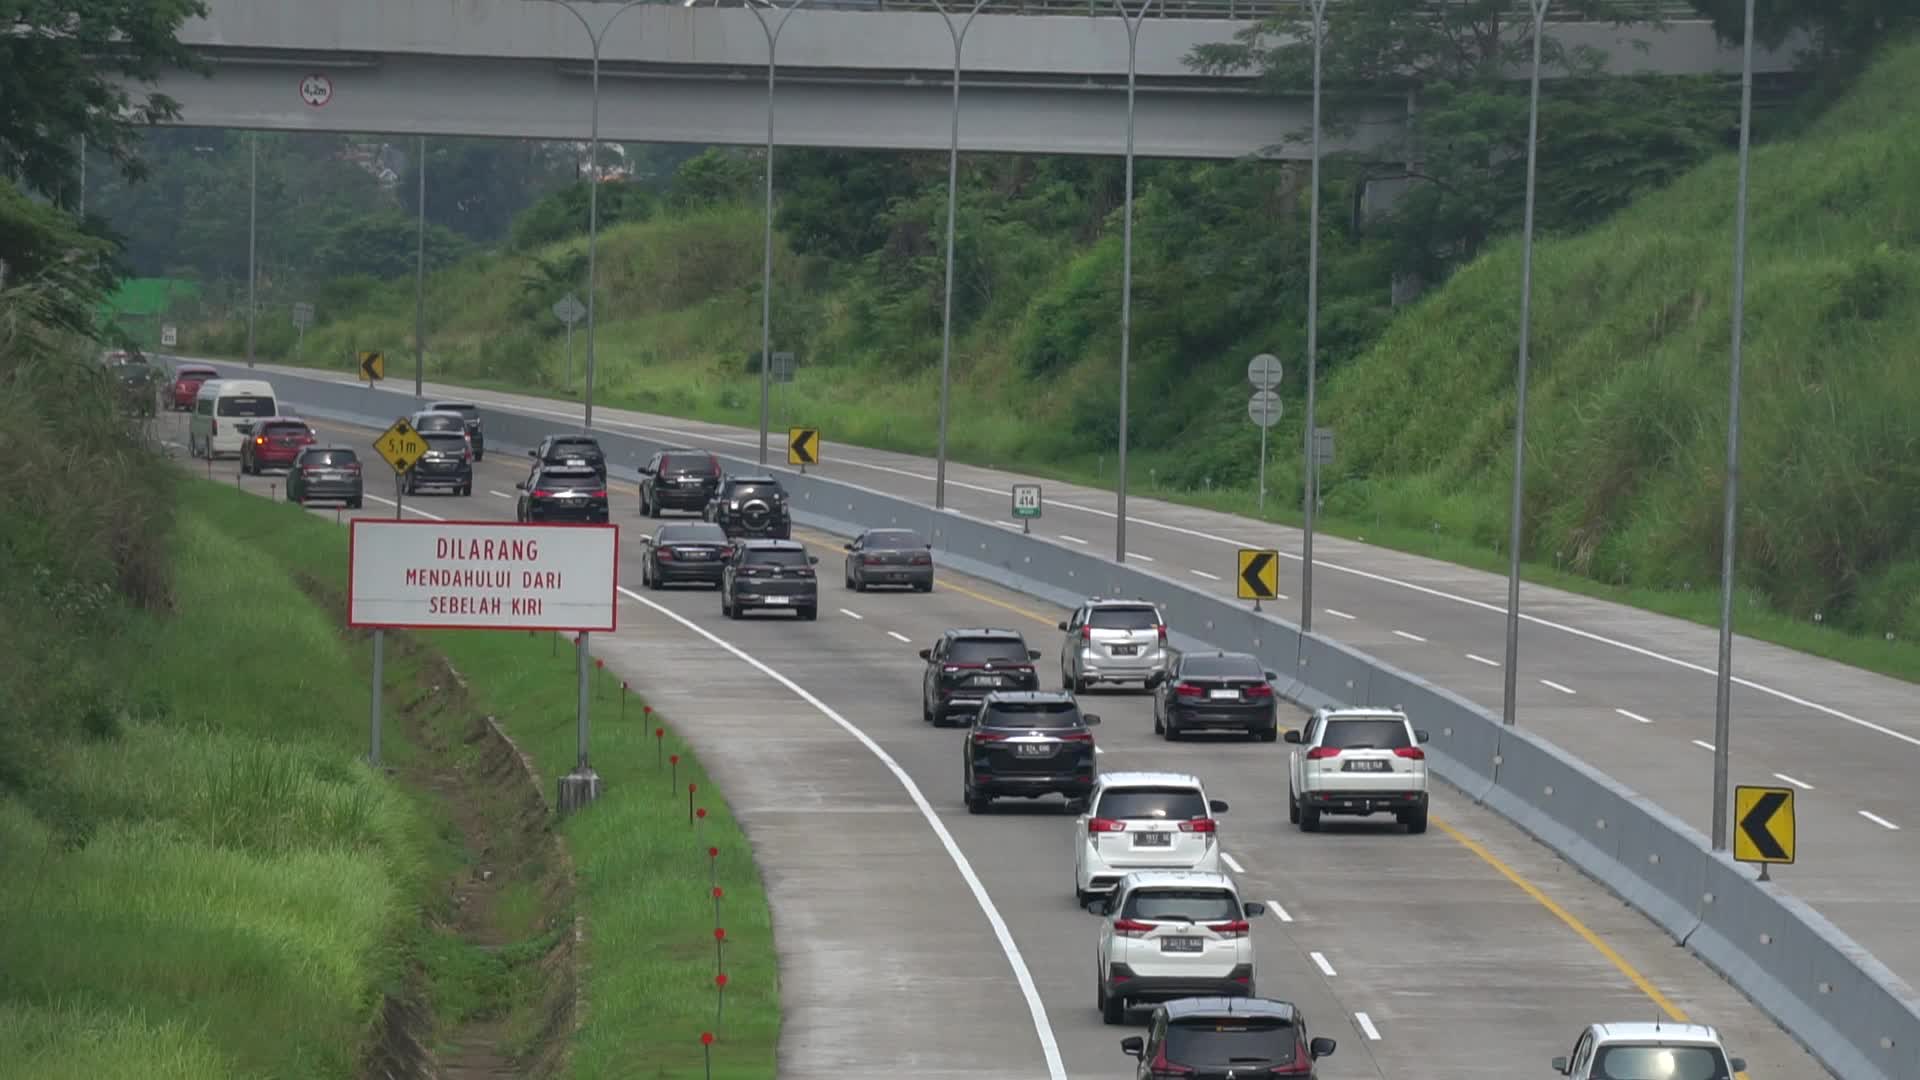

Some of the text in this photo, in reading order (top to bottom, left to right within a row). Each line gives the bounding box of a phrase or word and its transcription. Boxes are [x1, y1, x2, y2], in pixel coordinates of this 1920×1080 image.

[388, 438, 416, 455] 5,1m
[1019, 495, 1034, 505] 414
[437, 537, 538, 561] DILARANG
[406, 568, 562, 590] MENDAHULUI DARI
[428, 595, 542, 616] SEBELAH KIRI
